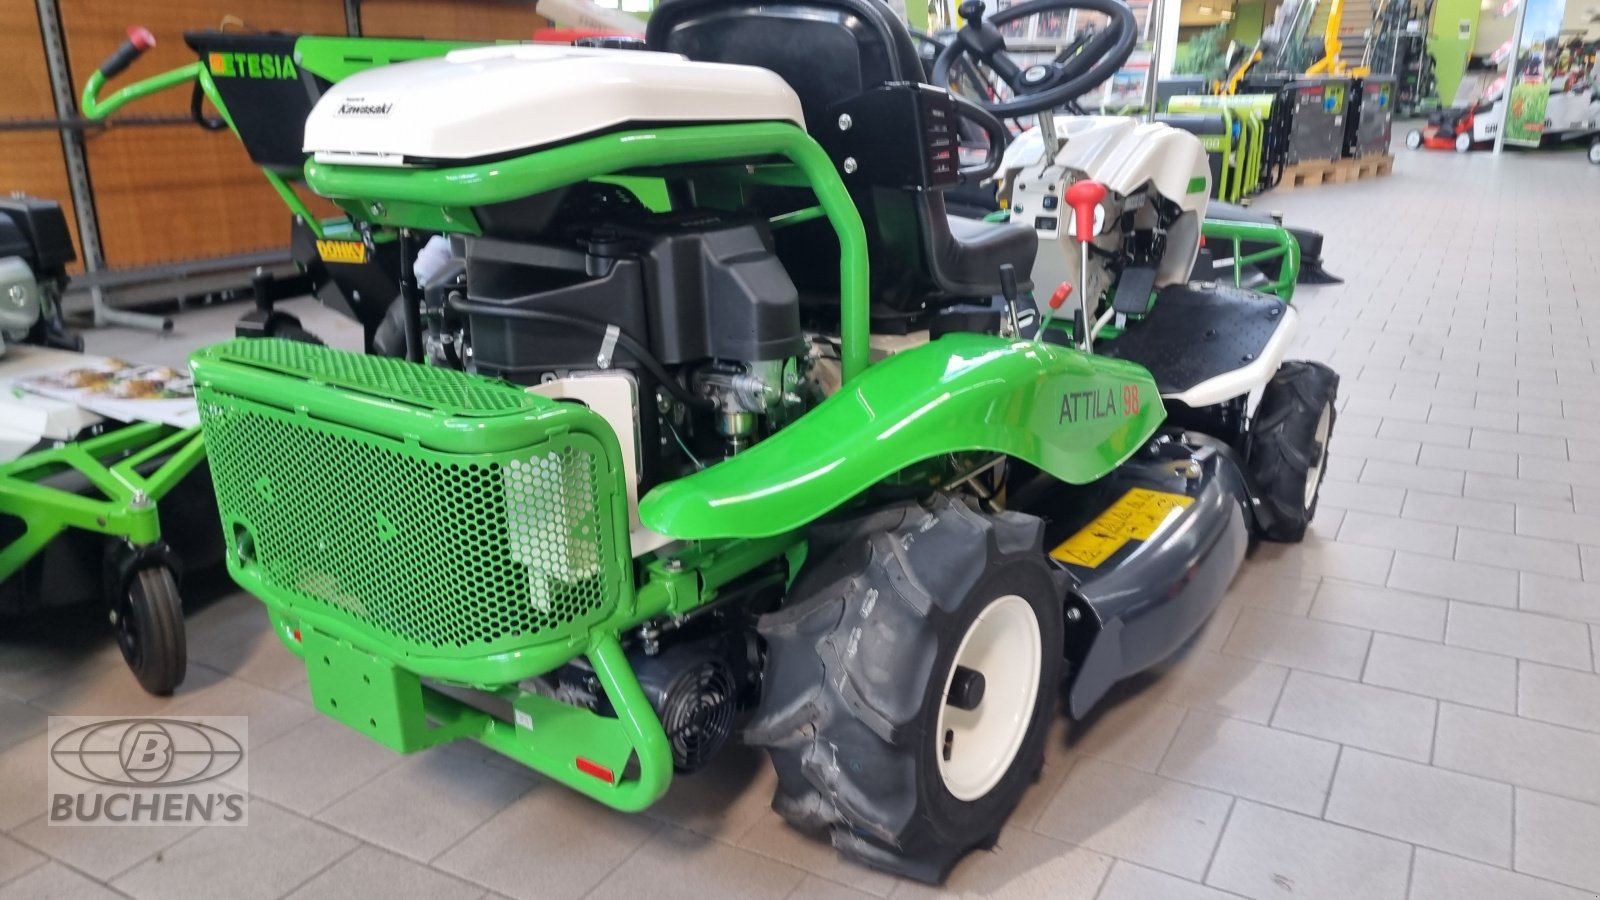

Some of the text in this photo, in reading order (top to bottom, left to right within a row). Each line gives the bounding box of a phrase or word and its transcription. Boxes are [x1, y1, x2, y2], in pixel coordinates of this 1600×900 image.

[220, 52, 298, 79] ETESIA
[338, 102, 392, 114] Kawasaki
[1059, 383, 1139, 424] ATTILA 98
